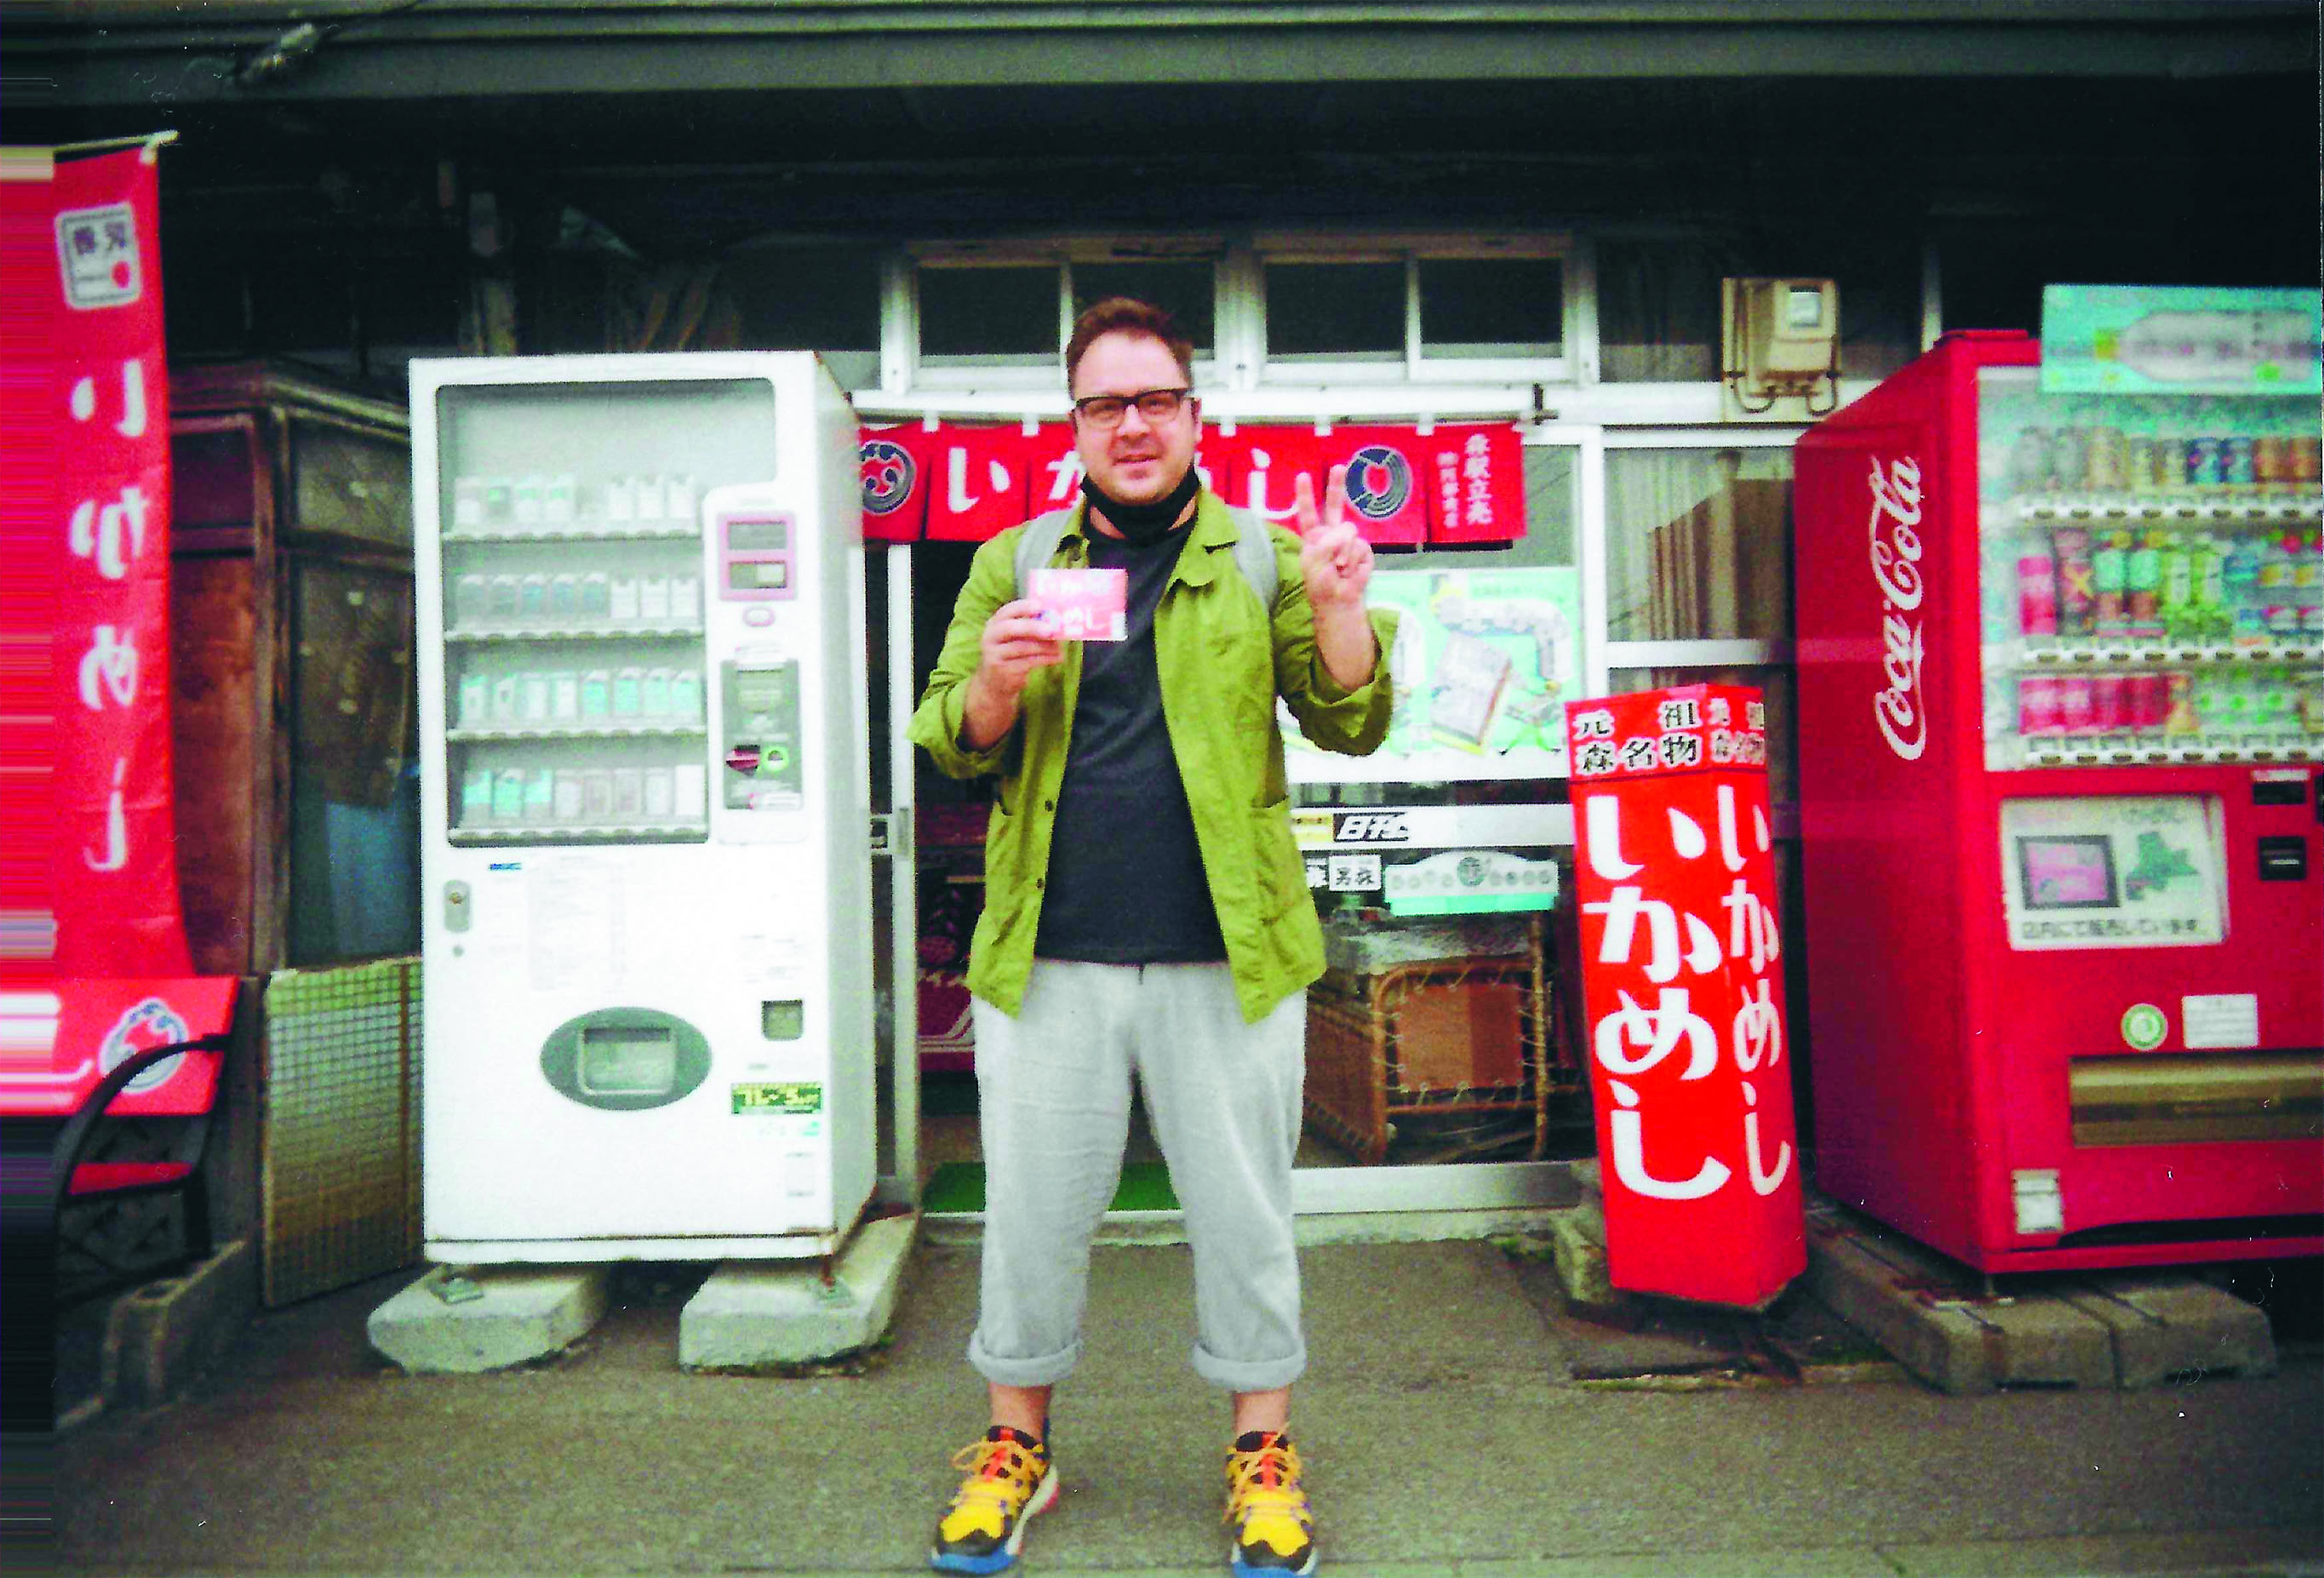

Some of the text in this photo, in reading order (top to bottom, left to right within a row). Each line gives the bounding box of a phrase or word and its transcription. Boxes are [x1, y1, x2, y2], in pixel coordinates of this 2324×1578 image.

[1577, 732, 1702, 774] 森名物
[1869, 453, 1926, 760] Coca-Cola
[1582, 795, 1732, 1200] いかめし
[1716, 784, 1791, 1196] いかめし
